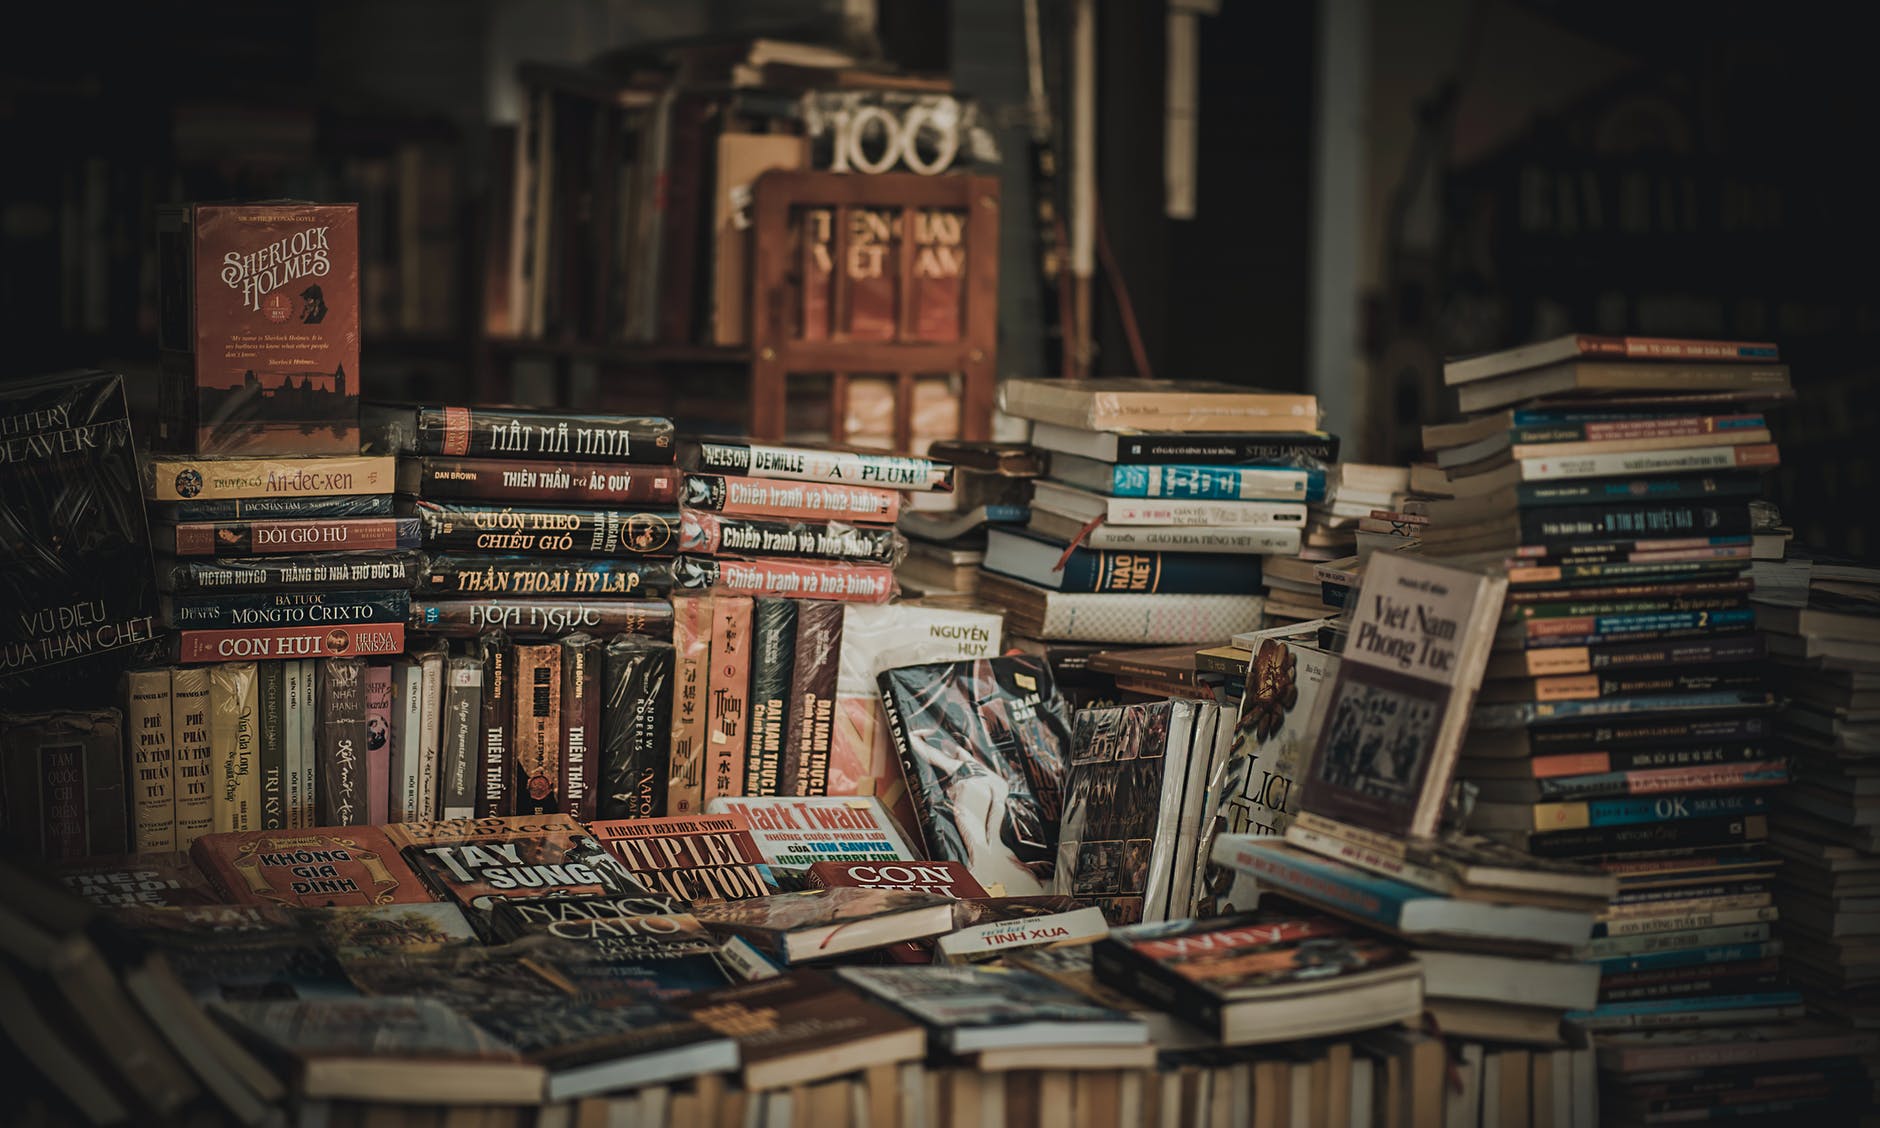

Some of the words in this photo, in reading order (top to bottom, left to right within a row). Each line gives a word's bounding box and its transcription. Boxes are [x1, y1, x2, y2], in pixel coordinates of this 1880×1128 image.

[221, 226, 330, 289] SHERLOCK
[242, 249, 331, 312] HOLMES
[490, 419, 532, 451] MẬT
[538, 422, 569, 453] MÃ
[575, 428, 631, 456] MAYA
[704, 446, 749, 469] NELSON
[755, 451, 805, 473] DEMILLE
[434, 471, 450, 480] DAN
[450, 472, 477, 481] BROWN
[502, 469, 537, 488] THIÊN
[539, 467, 570, 489] THẦN
[588, 472, 606, 491] ÁC
[861, 465, 915, 484] PLUM
[731, 481, 767, 505] Chiến
[770, 486, 802, 508] tranh
[806, 489, 820, 510] và
[474, 507, 526, 530] CUỐN
[530, 513, 581, 531] THEO
[290, 525, 320, 543] GIÓ
[322, 525, 348, 542] HÚ
[477, 531, 535, 550] CHIỀU
[539, 531, 574, 551] GIÓ
[591, 511, 604, 552] MITCHELL
[604, 510, 619, 553] MARGARET
[723, 526, 760, 549] Chiến
[762, 531, 797, 552] tranh
[799, 531, 814, 553] và
[1172, 535, 1200, 545] KHOA
[199, 570, 233, 586] VICTOR
[235, 569, 267, 585] HUYGO
[280, 563, 313, 583] THẰNG
[314, 566, 327, 582] GÙ
[329, 564, 349, 581] NHÀ
[351, 563, 370, 580] THỜ
[371, 560, 391, 580] ĐỨC
[392, 560, 406, 578] BÀ
[457, 565, 510, 592] THẦN
[726, 566, 764, 589] Chiến
[766, 571, 800, 591] tranh
[802, 572, 818, 592] và
[21, 607, 55, 637] VŨ
[58, 599, 106, 630] ĐIỆU
[426, 607, 438, 622] vh
[1375, 595, 1410, 630] Việt
[1411, 604, 1457, 641] Nam
[1698, 611, 1709, 628] 2
[97, 615, 153, 648] CHẾT
[355, 632, 392, 643] HELENA
[218, 637, 271, 656] CON
[276, 633, 323, 654] HỦI
[355, 641, 397, 652] MNISZEK
[1356, 621, 1416, 669] Phong
[494, 653, 503, 669] DAN
[575, 653, 583, 669] DAN
[267, 674, 277, 701] THÍCH
[332, 678, 358, 688] THÍCH
[493, 670, 503, 699] BROWN
[534, 667, 551, 685] DAN
[575, 670, 583, 699] BROWN
[332, 688, 356, 699] NHẤT
[533, 686, 551, 717] BROWN
[714, 688, 742, 720] Thủy
[238, 706, 253, 732] Vua
[266, 703, 277, 723] NHẤT
[331, 702, 358, 712] HẠNH
[459, 700, 469, 722] Dilgo
[767, 699, 783, 720] ĐẠI
[816, 699, 832, 721] ĐẠI
[183, 727, 207, 743] PHÁN
[634, 698, 646, 752] ROBERTS
[645, 698, 655, 749] ANDREW
[802, 719, 813, 738] biên
[140, 731, 165, 746] PHÁN
[266, 724, 277, 751] HẠNH
[487, 726, 505, 763] THIÊN
[568, 726, 587, 763] THIÊN
[764, 722, 781, 751] NAM
[813, 722, 830, 751] NAM
[135, 748, 148, 763] LÝ
[150, 747, 170, 763] TÍNH
[178, 745, 190, 761] LÝ
[192, 744, 211, 760] TÍNH
[236, 752, 251, 776] Long
[265, 766, 280, 792] TRI
[456, 759, 467, 797] Rinpoche
[760, 753, 778, 787] THỰC
[809, 753, 827, 787] THỰC
[146, 782, 165, 797] TÚY
[187, 778, 206, 795] TÚY
[486, 765, 506, 800] THẦN
[567, 765, 588, 800] THẦN
[728, 802, 801, 831] Mark
[792, 802, 880, 830] Twain
[1654, 796, 1690, 819] OK
[407, 818, 505, 831] DAVID
[412, 823, 574, 839] BALDACCI
[605, 824, 651, 837] HARRIET
[652, 822, 700, 835] BEECHER
[699, 819, 737, 832] STOWE
[258, 849, 352, 867] KHÔNG
[788, 842, 811, 854] CỦA
[808, 841, 838, 853] TOM
[841, 841, 895, 853] SAWYER
[871, 853, 901, 862] FINN
[291, 864, 338, 879] GIA
[424, 843, 524, 882] TAY
[847, 865, 955, 884] CON
[290, 877, 359, 895] ĐÌNH
[514, 897, 677, 924] NANCY
[548, 916, 681, 940] CATO
